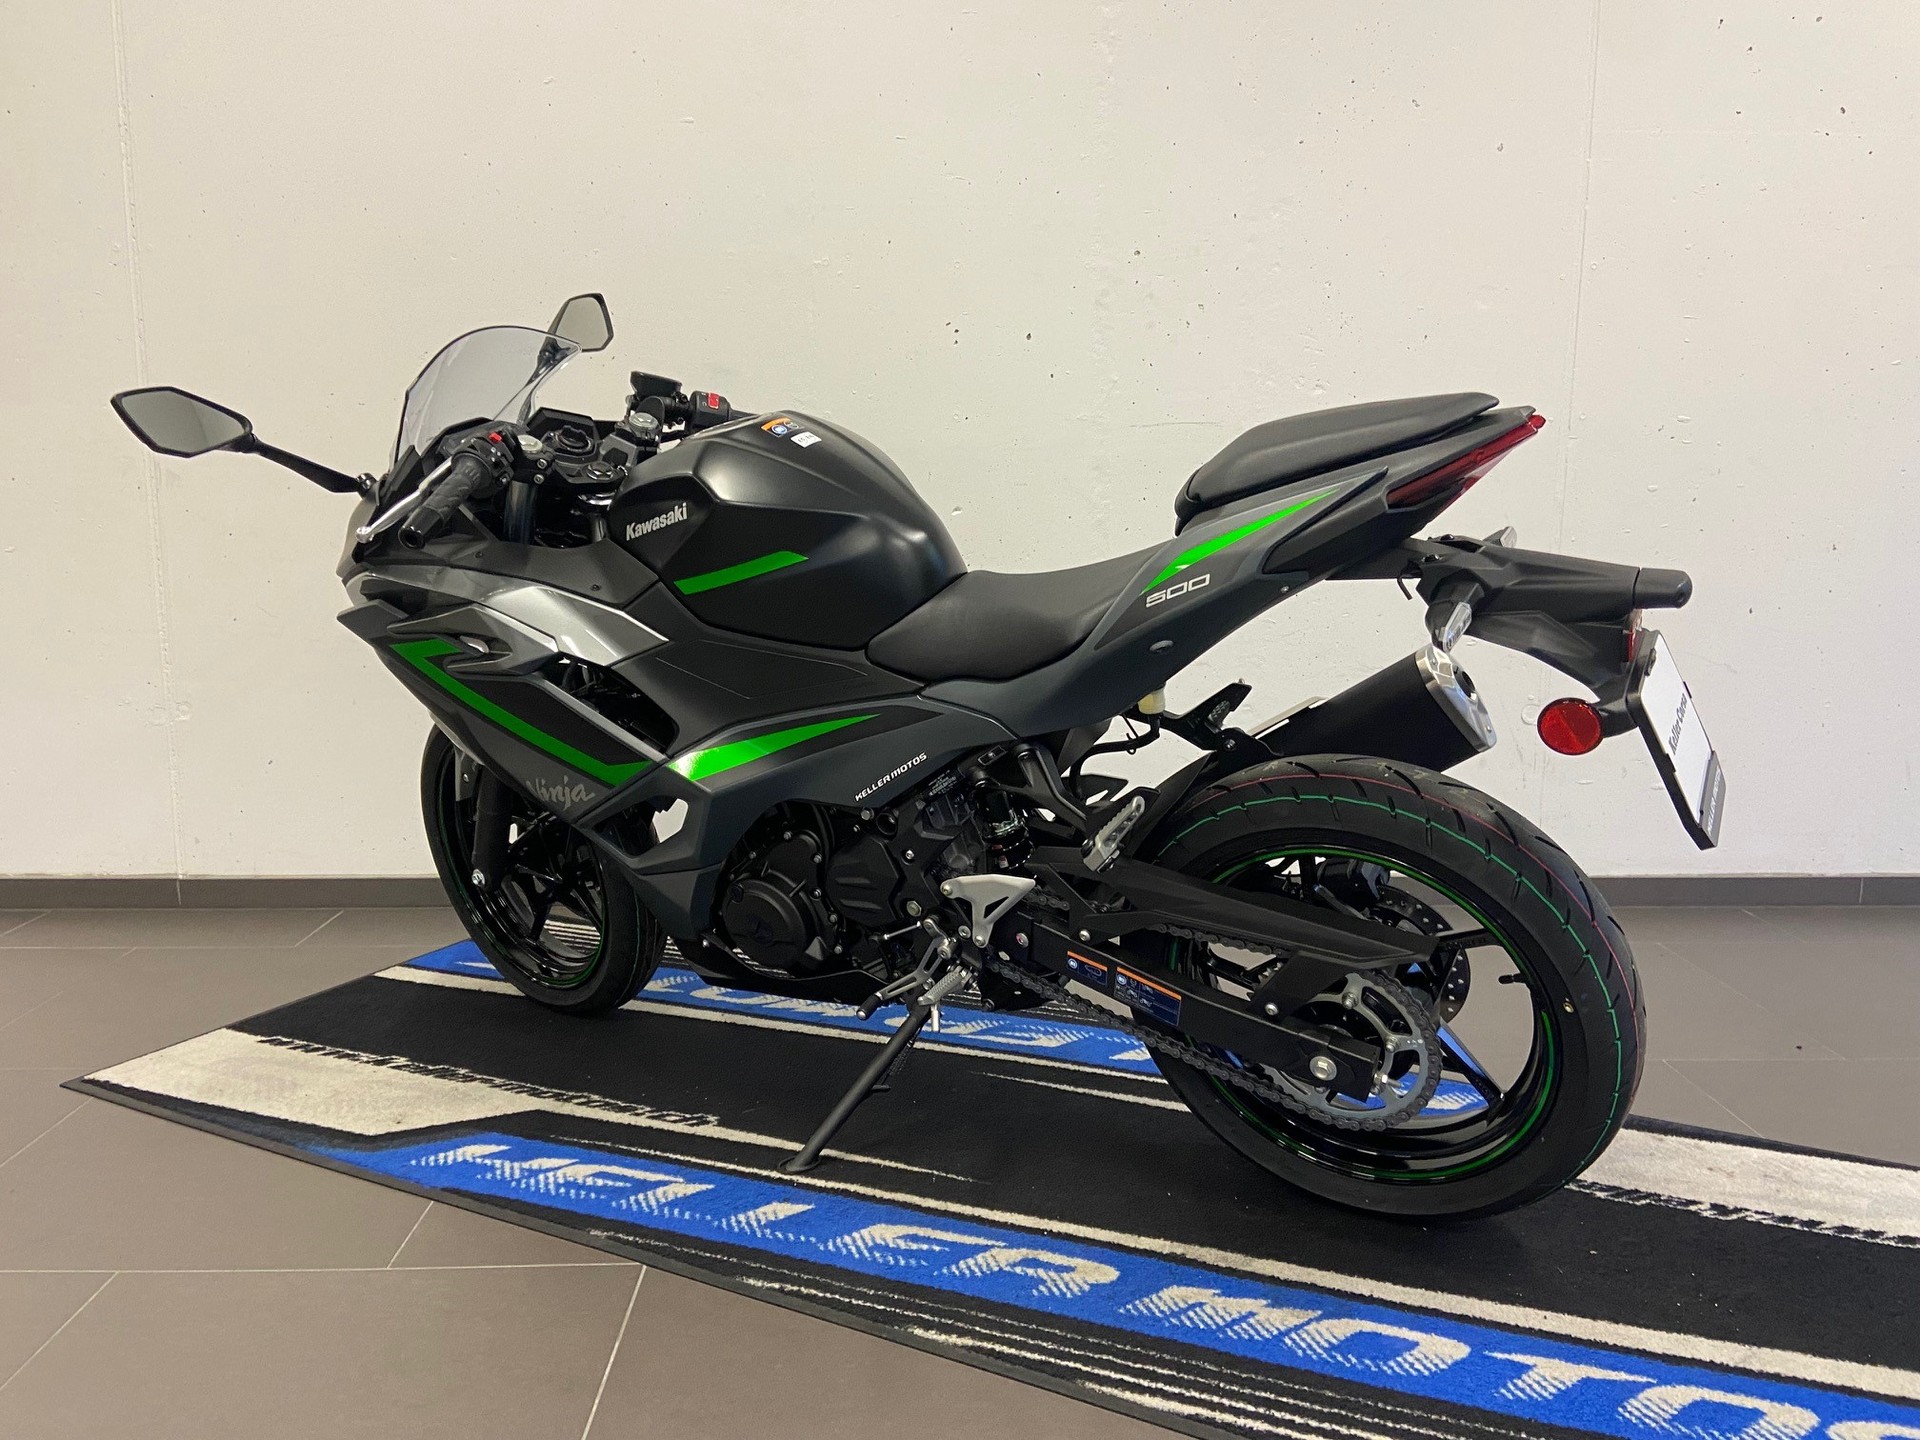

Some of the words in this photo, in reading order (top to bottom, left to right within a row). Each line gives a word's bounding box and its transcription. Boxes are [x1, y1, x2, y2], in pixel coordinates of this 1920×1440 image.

[626, 502, 687, 541] Kawasaki
[1146, 573, 1211, 608] 500
[525, 774, 596, 812] Ninja
[854, 772, 892, 801] KELLER
[890, 752, 928, 780] MOTOS
[410, 1143, 1122, 1299] KELLER
[1117, 1285, 1920, 1440] MOTO
